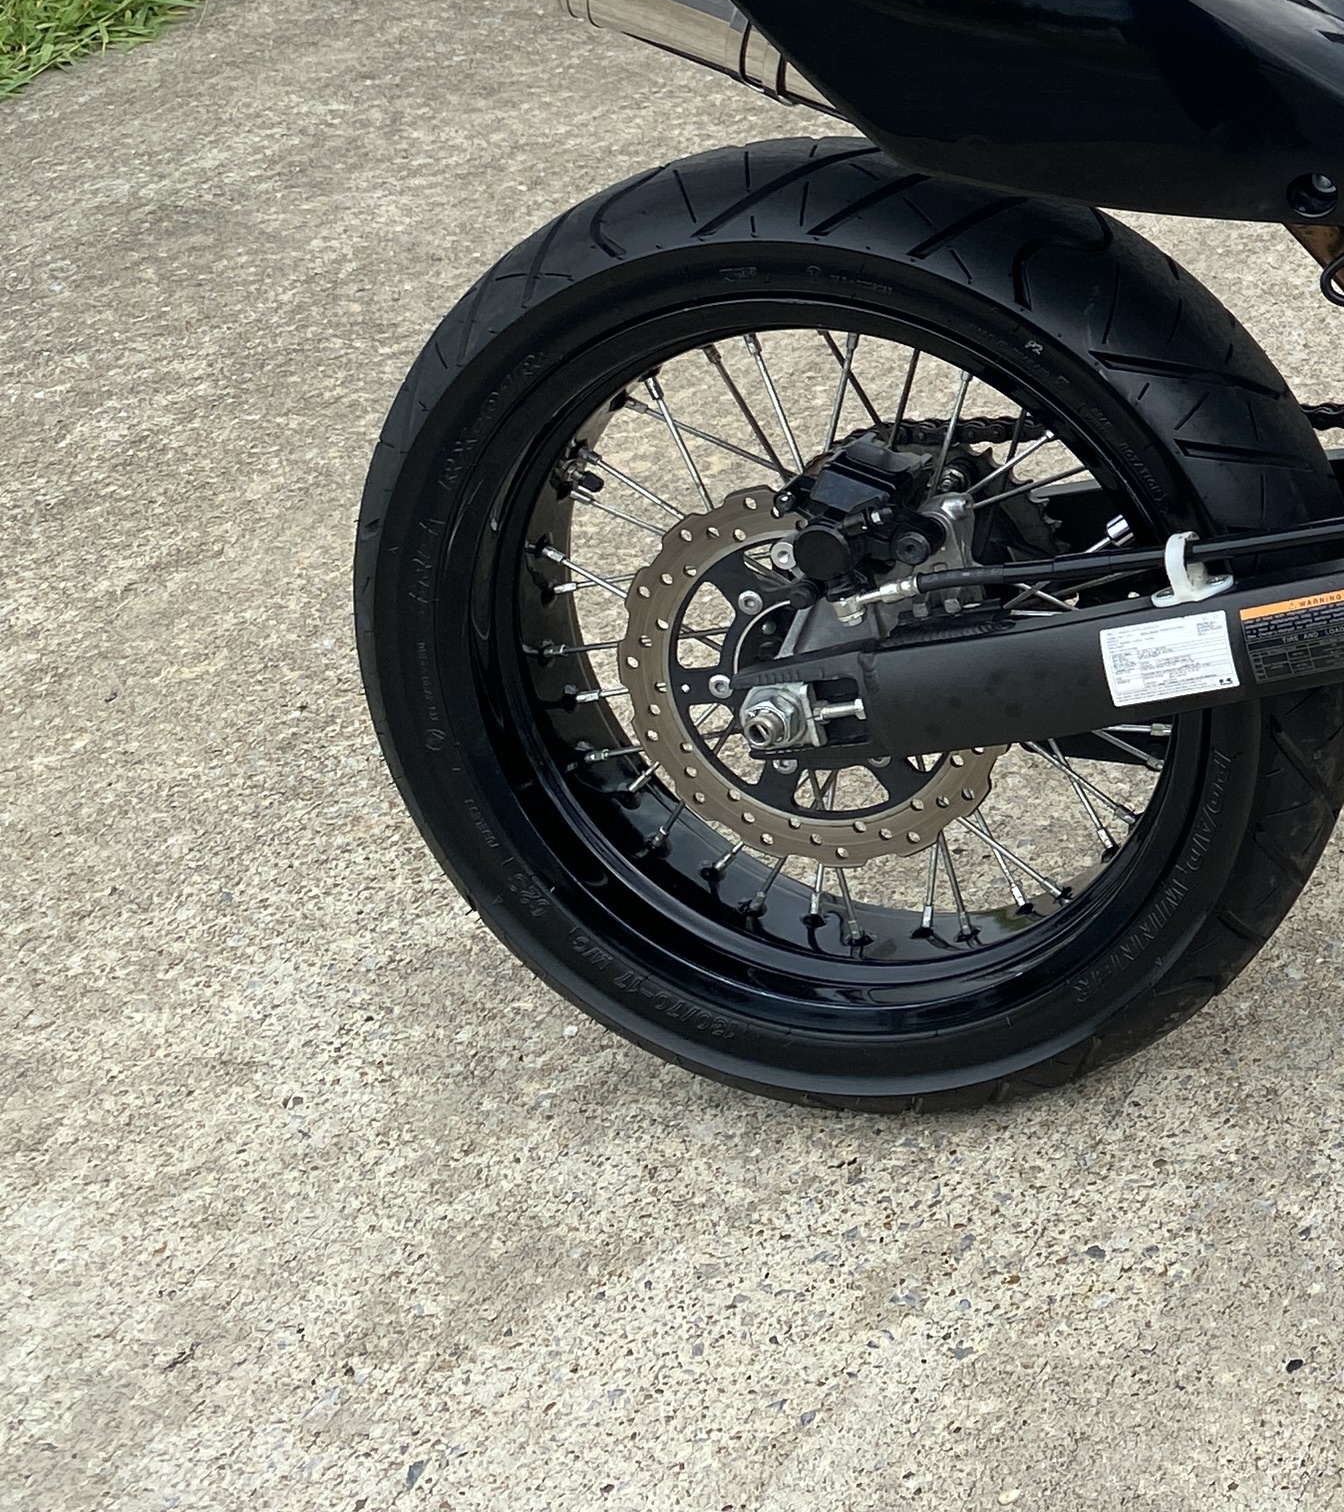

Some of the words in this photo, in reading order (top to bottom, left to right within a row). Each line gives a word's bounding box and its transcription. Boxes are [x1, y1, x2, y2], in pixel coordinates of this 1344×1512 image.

[1298, 593, 1342, 607] WARNING
[1282, 635, 1299, 644] TIRE
[1303, 631, 1319, 640] AND
[1325, 626, 1344, 636] LOAD
